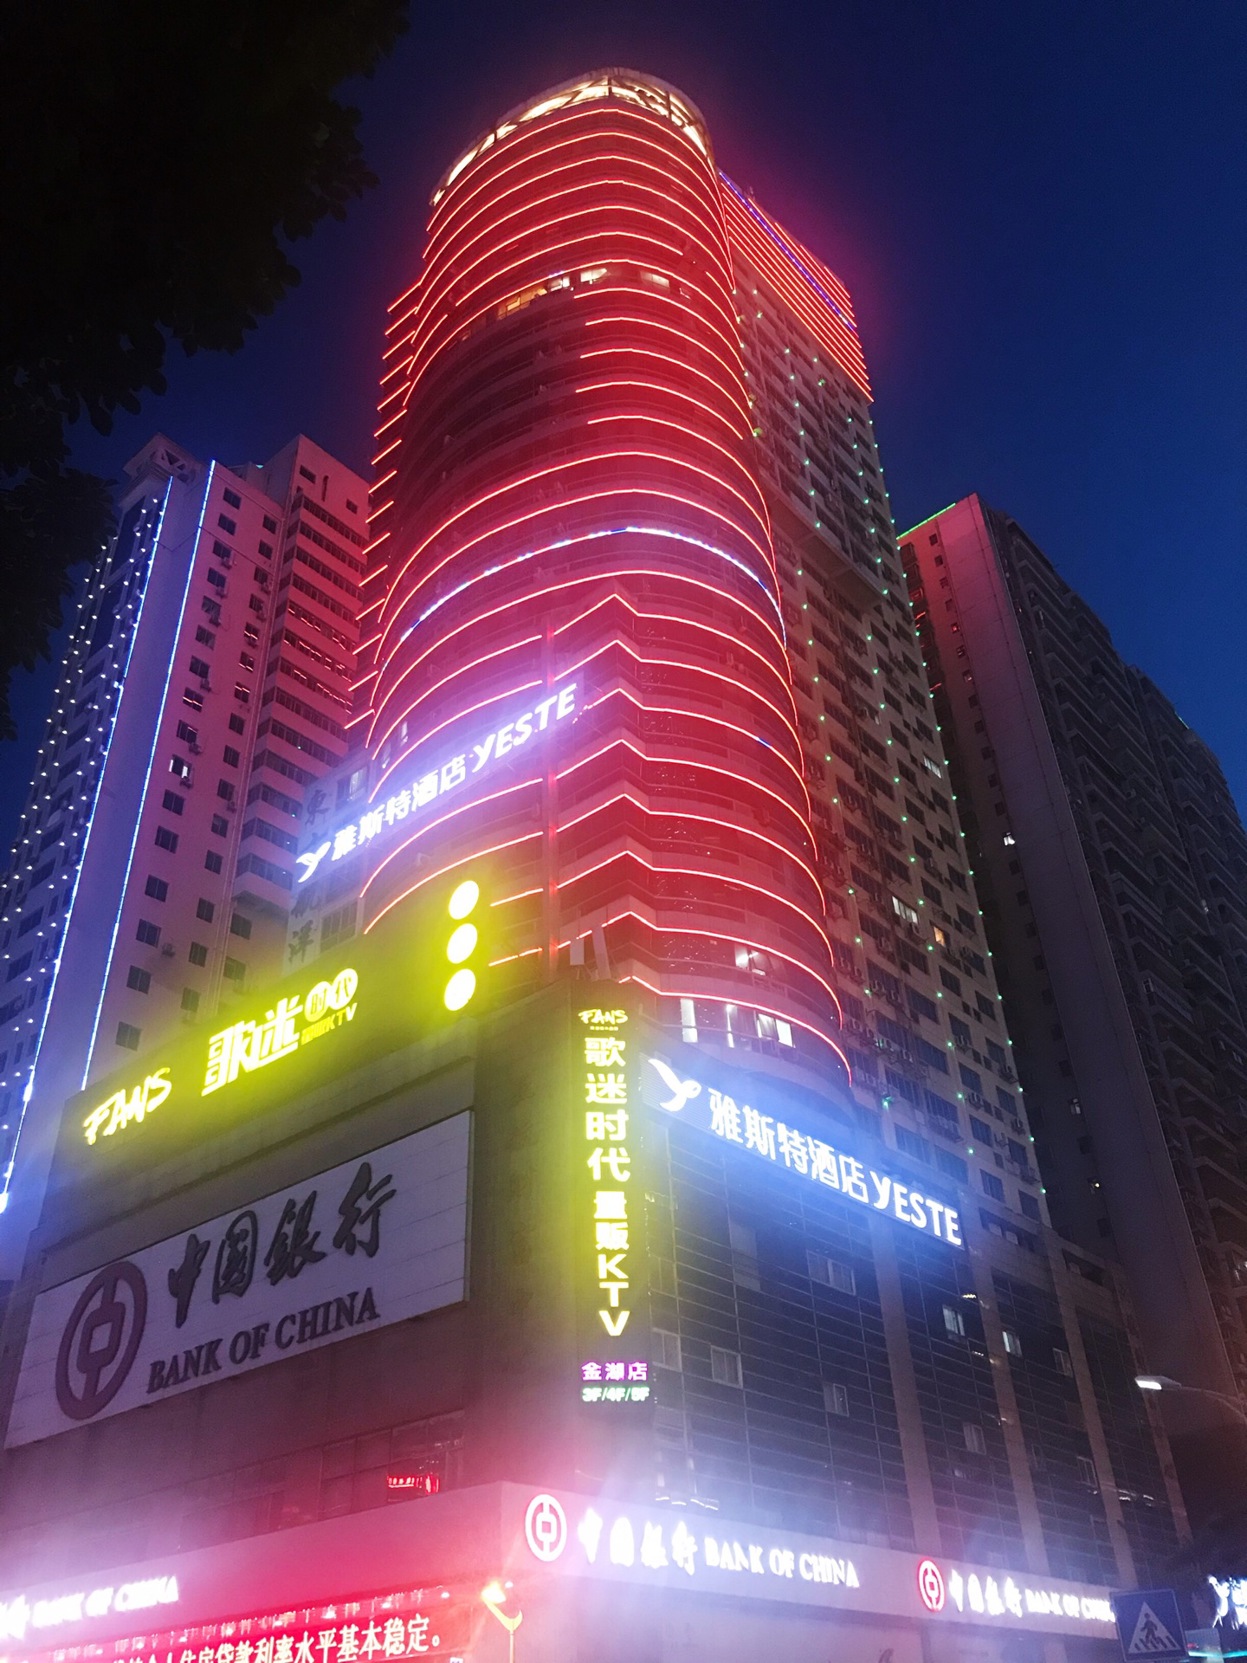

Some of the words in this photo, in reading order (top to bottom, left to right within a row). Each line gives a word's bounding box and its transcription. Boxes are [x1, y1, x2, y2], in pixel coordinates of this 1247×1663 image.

[471, 683, 577, 773] YESTE
[578, 1009, 628, 1025] FANS
[83, 1067, 172, 1145] FANS
[708, 1088, 868, 1204] 雅斯特酒店
[869, 1170, 963, 1246] YESTE
[146, 1338, 222, 1394] BANK
[229, 1322, 268, 1366] OF
[275, 1286, 380, 1347] CHINA
[581, 1362, 648, 1381] 金湖店
[704, 1536, 764, 1574] BANK
[769, 1548, 795, 1578] OF
[799, 1553, 860, 1588] CHINA
